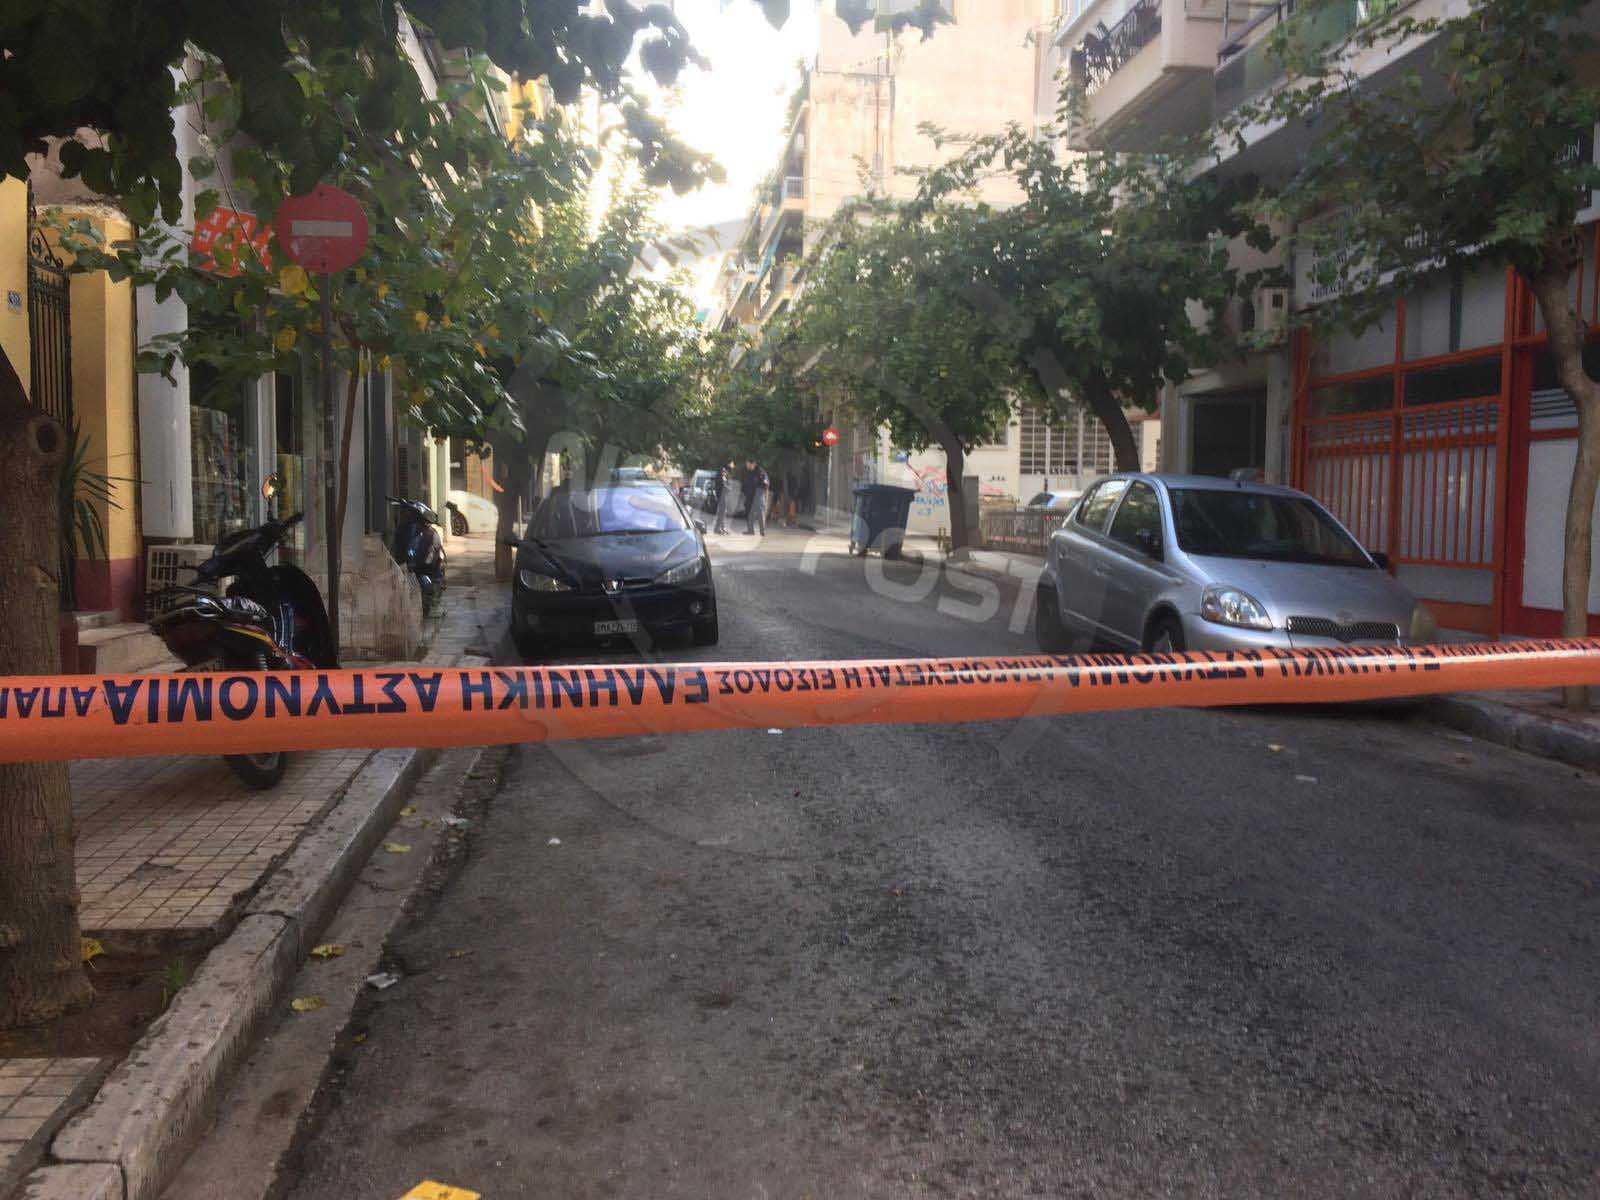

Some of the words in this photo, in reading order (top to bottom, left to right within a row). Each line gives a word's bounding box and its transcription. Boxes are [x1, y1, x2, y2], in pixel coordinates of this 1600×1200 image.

[102, 672, 442, 725] ΑΣΤΥΝΟΜΙΑ
[460, 668, 709, 712] ΕΛΛΗΝΙΚΗ
[713, 668, 836, 694] ΕΙΣΟΔΟΣ
